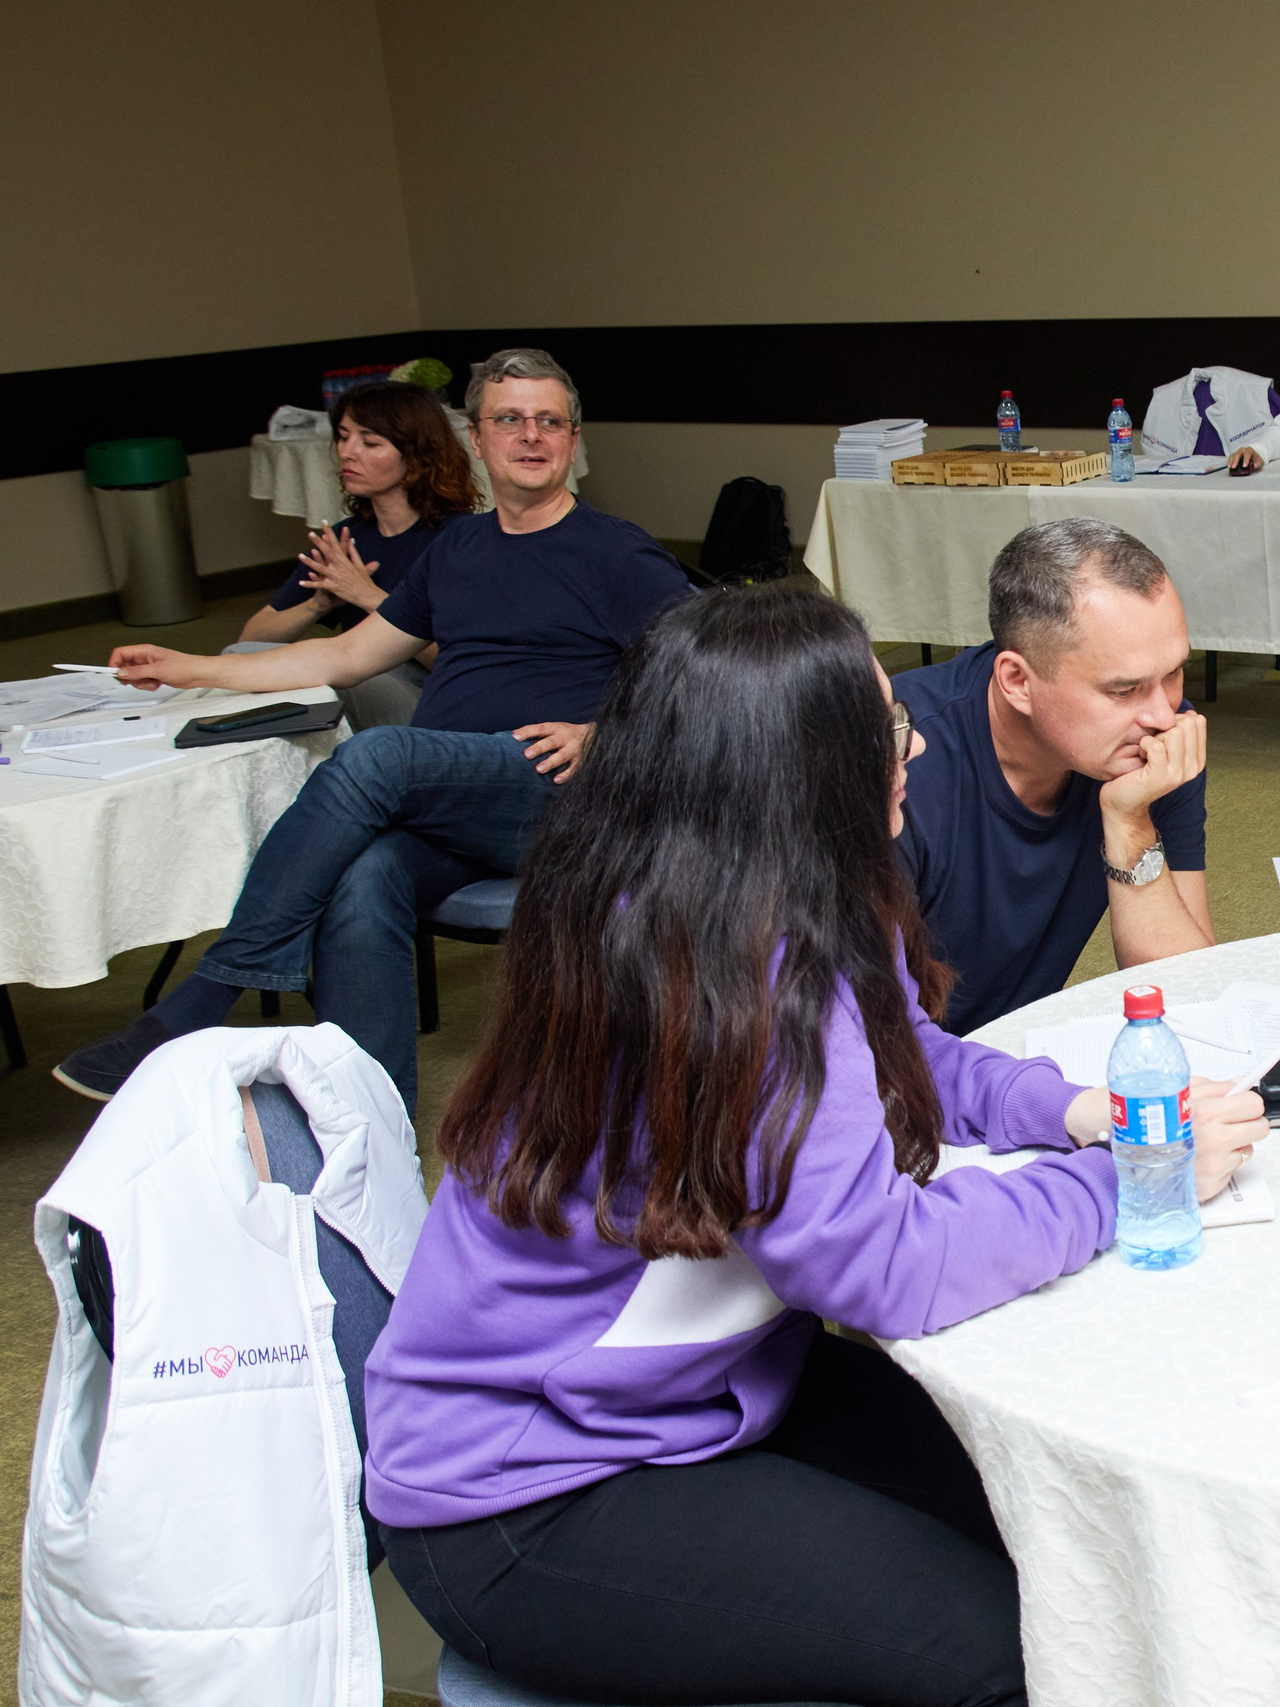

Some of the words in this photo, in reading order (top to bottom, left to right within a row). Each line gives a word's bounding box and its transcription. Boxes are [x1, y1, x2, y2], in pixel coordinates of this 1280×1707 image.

[1229, 421, 1266, 443] КООРДИНАТОР
[1156, 440, 1178, 454] КОМАНДА
[153, 1356, 204, 1379] #МЫ
[237, 1344, 310, 1367] КОМАНДА
